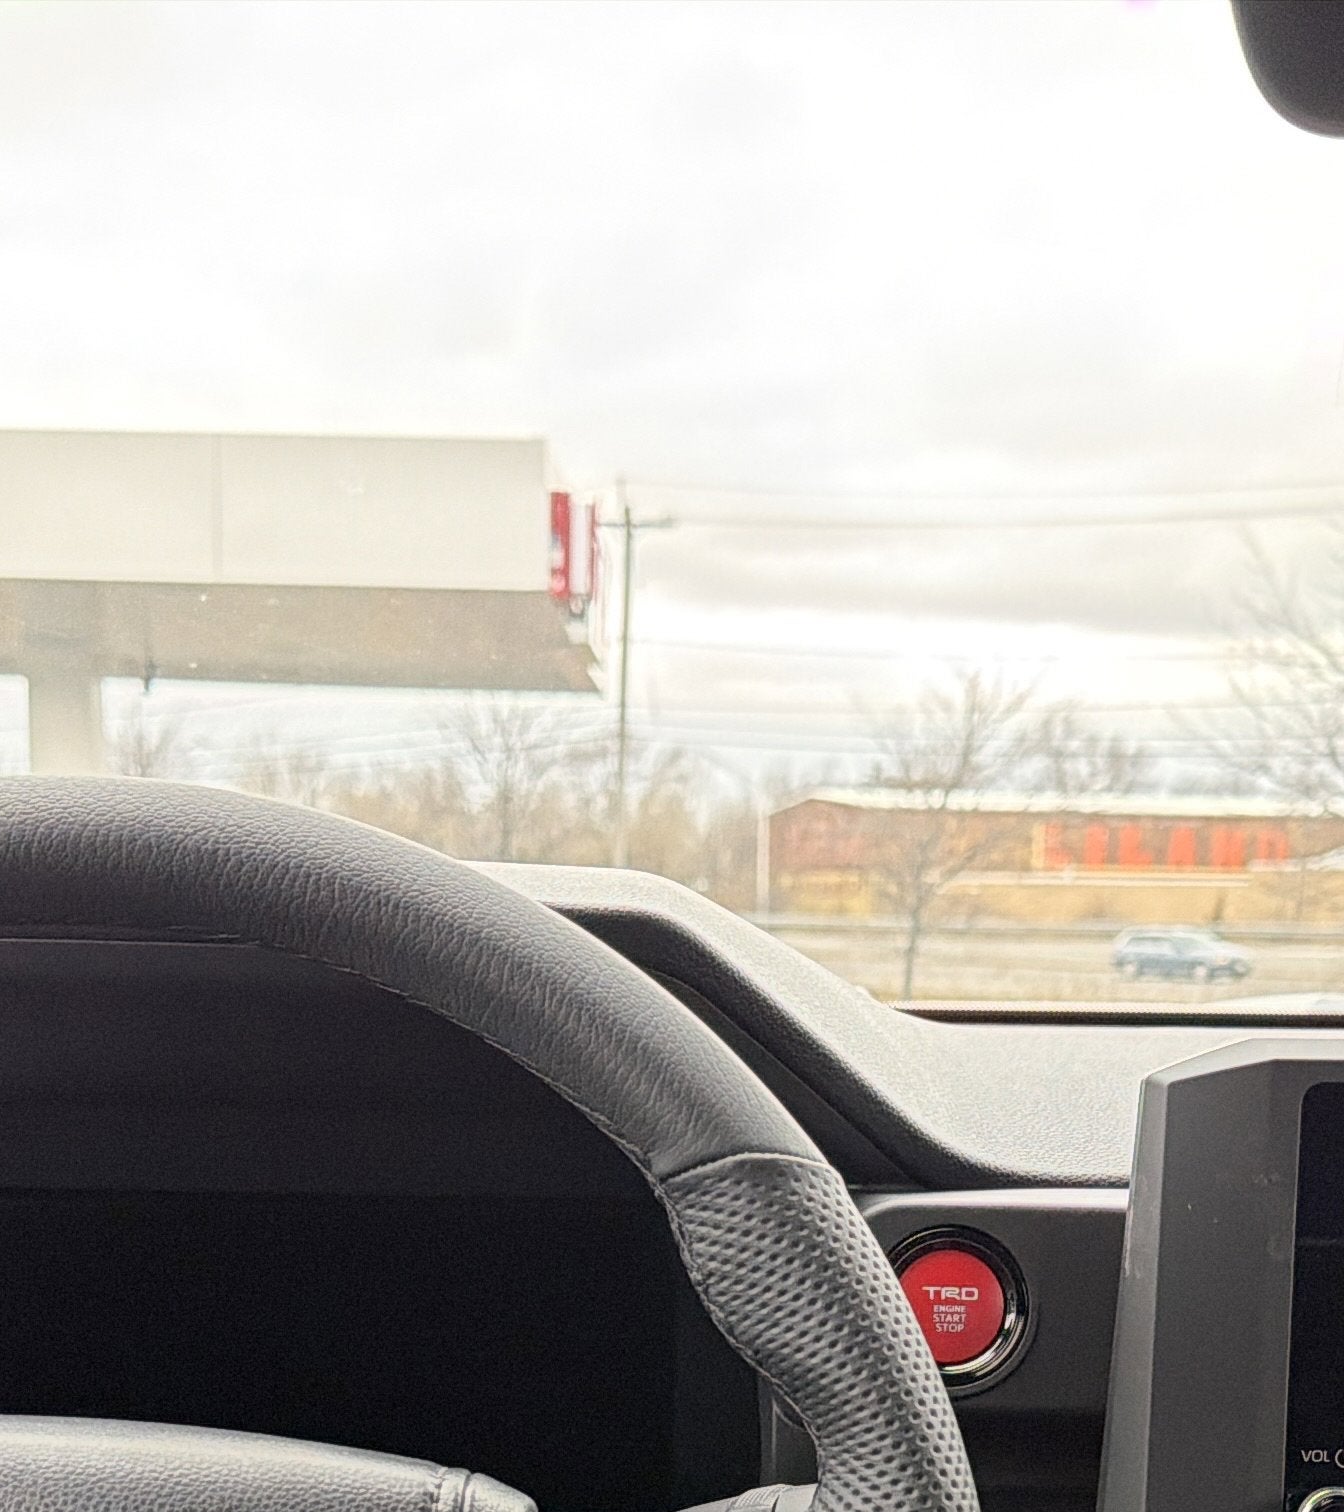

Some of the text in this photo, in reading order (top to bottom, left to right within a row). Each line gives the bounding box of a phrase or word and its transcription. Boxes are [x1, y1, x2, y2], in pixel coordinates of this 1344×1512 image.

[922, 1286, 979, 1301] TRD
[933, 1304, 966, 1314] ENGINE
[932, 1313, 967, 1323] START
[935, 1323, 965, 1333] STOP
[1301, 1449, 1331, 1463] VOL
